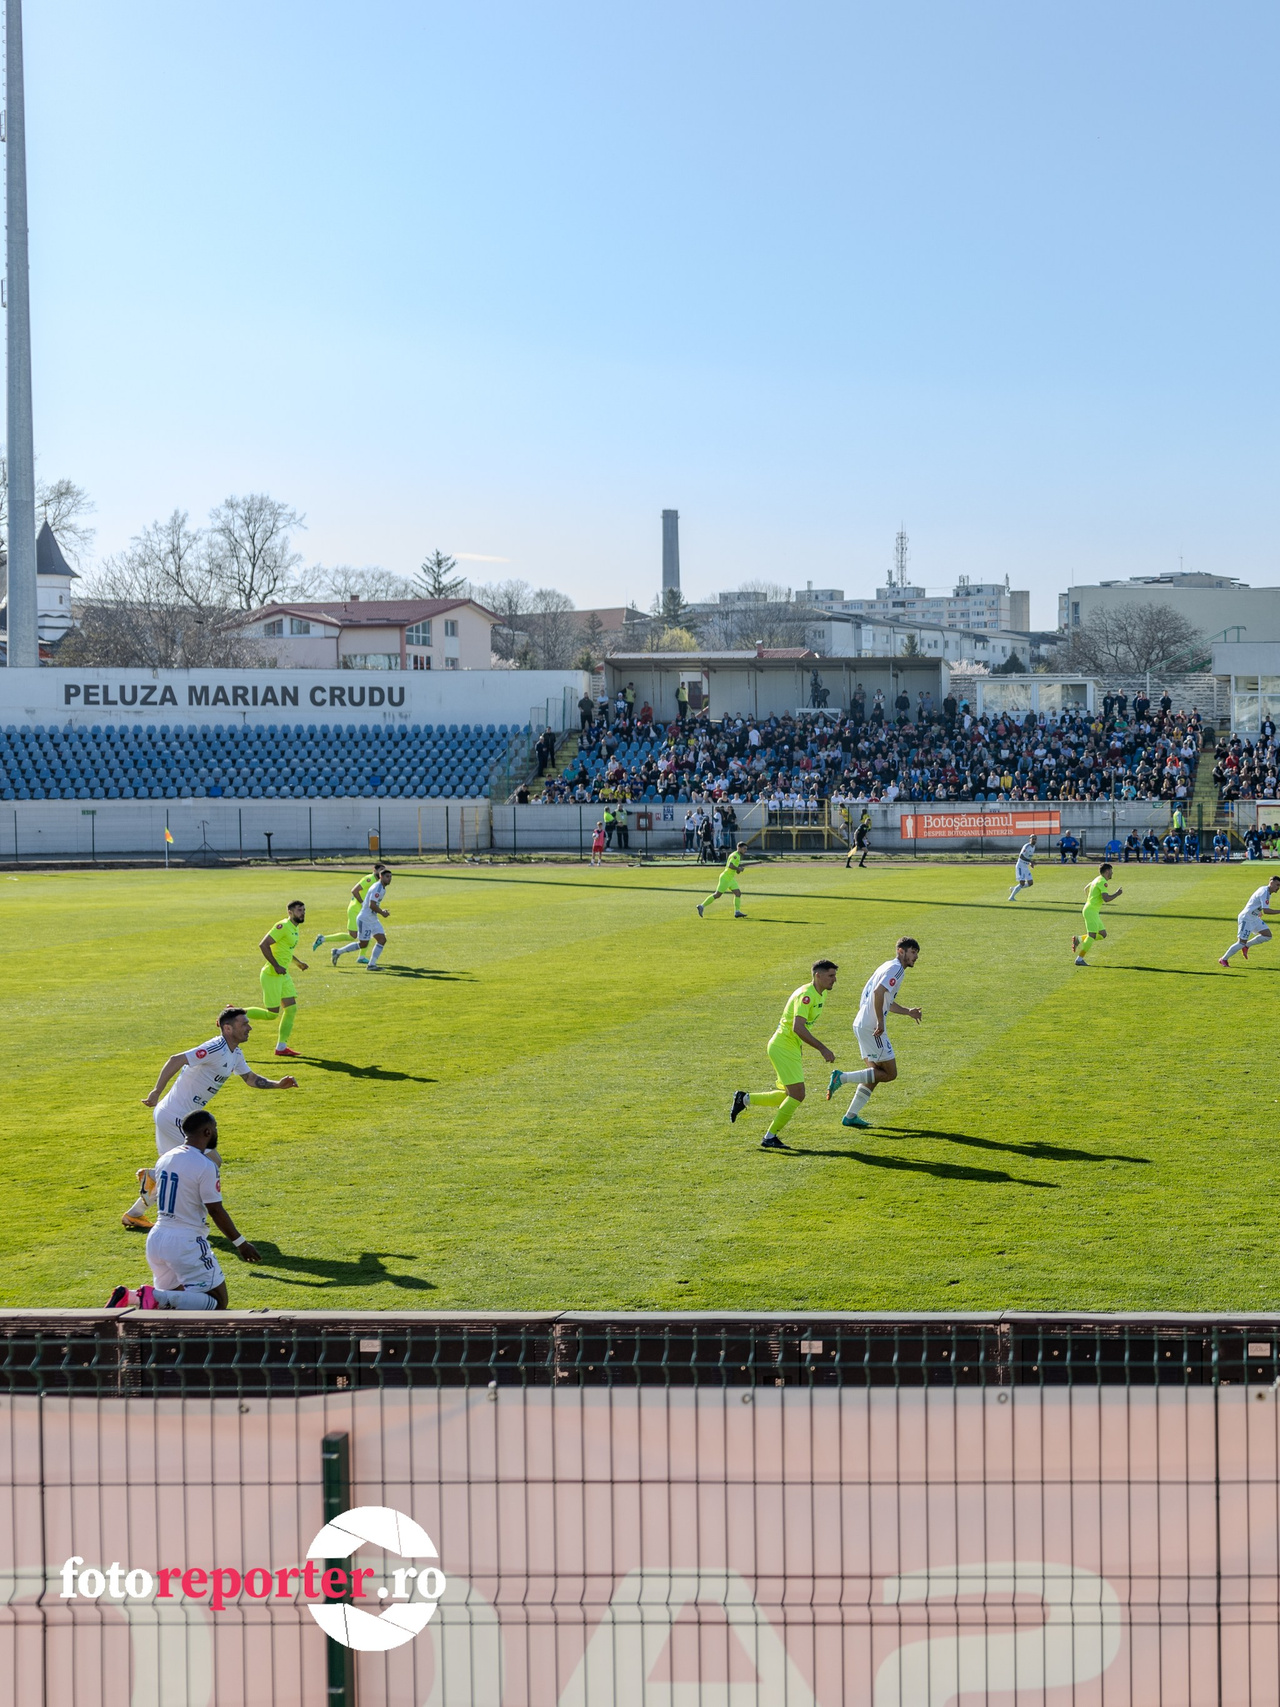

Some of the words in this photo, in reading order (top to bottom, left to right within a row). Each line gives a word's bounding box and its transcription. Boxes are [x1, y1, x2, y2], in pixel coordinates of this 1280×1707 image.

[64, 684, 178, 706] PELUZA
[188, 685, 299, 706] MARIAN
[309, 685, 405, 707] CRUDU
[159, 1170, 179, 1214] 11
